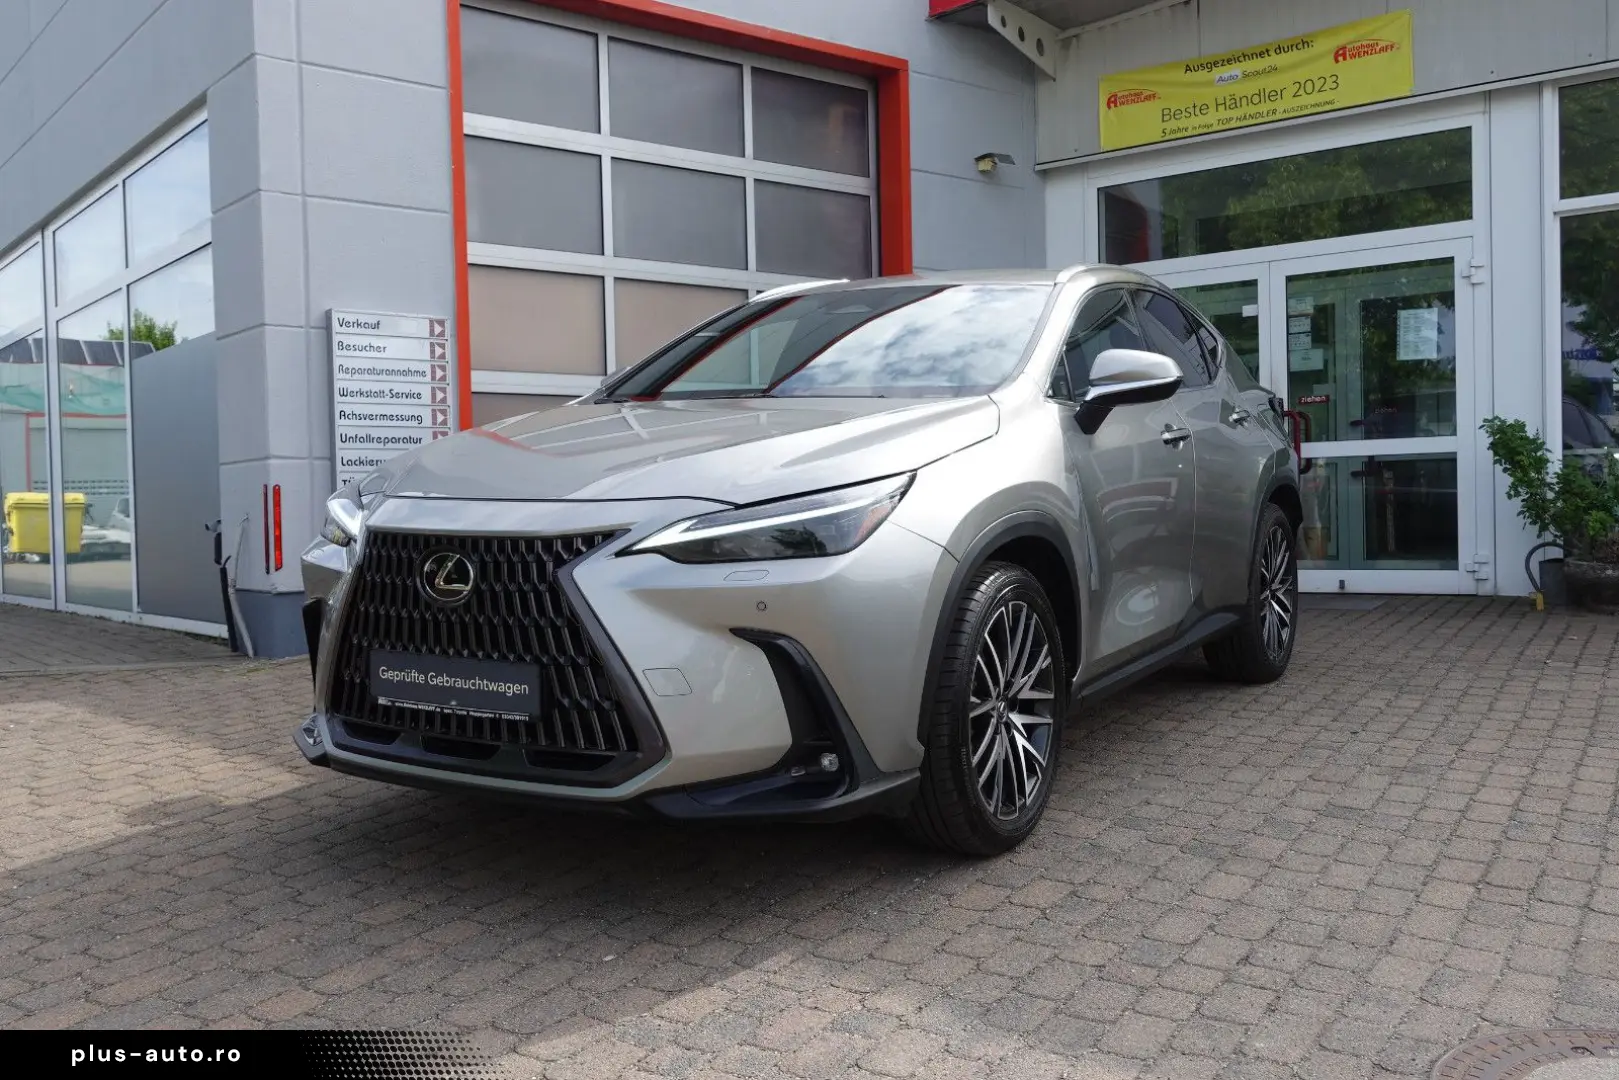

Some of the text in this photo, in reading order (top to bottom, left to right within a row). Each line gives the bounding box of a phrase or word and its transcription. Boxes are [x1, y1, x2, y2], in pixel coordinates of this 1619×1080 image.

[1184, 38, 1314, 74] Ausgezeichnet durch:
[1348, 43, 1395, 60] WENZLAFF
[1216, 64, 1278, 84] Auto Scout24
[1161, 74, 1339, 123] Beste Händler 2023
[1161, 128, 1167, 138] 5
[1168, 126, 1189, 136] Jahre
[1217, 117, 1234, 126] TOP
[1235, 108, 1277, 122] HÄNDLER
[1281, 100, 1336, 115] AUSZEICHNUNG
[337, 317, 381, 330] Verkauf
[337, 341, 387, 353] Besucher
[338, 364, 427, 378] Reparaturannahme
[338, 387, 422, 400] Werkstatt-Service
[339, 410, 423, 424] Achsvermessung
[340, 433, 423, 446] Unfallreparatur
[341, 456, 387, 467] Lackier
[379, 666, 529, 697] Geprüfte Gebrauchtwagen
